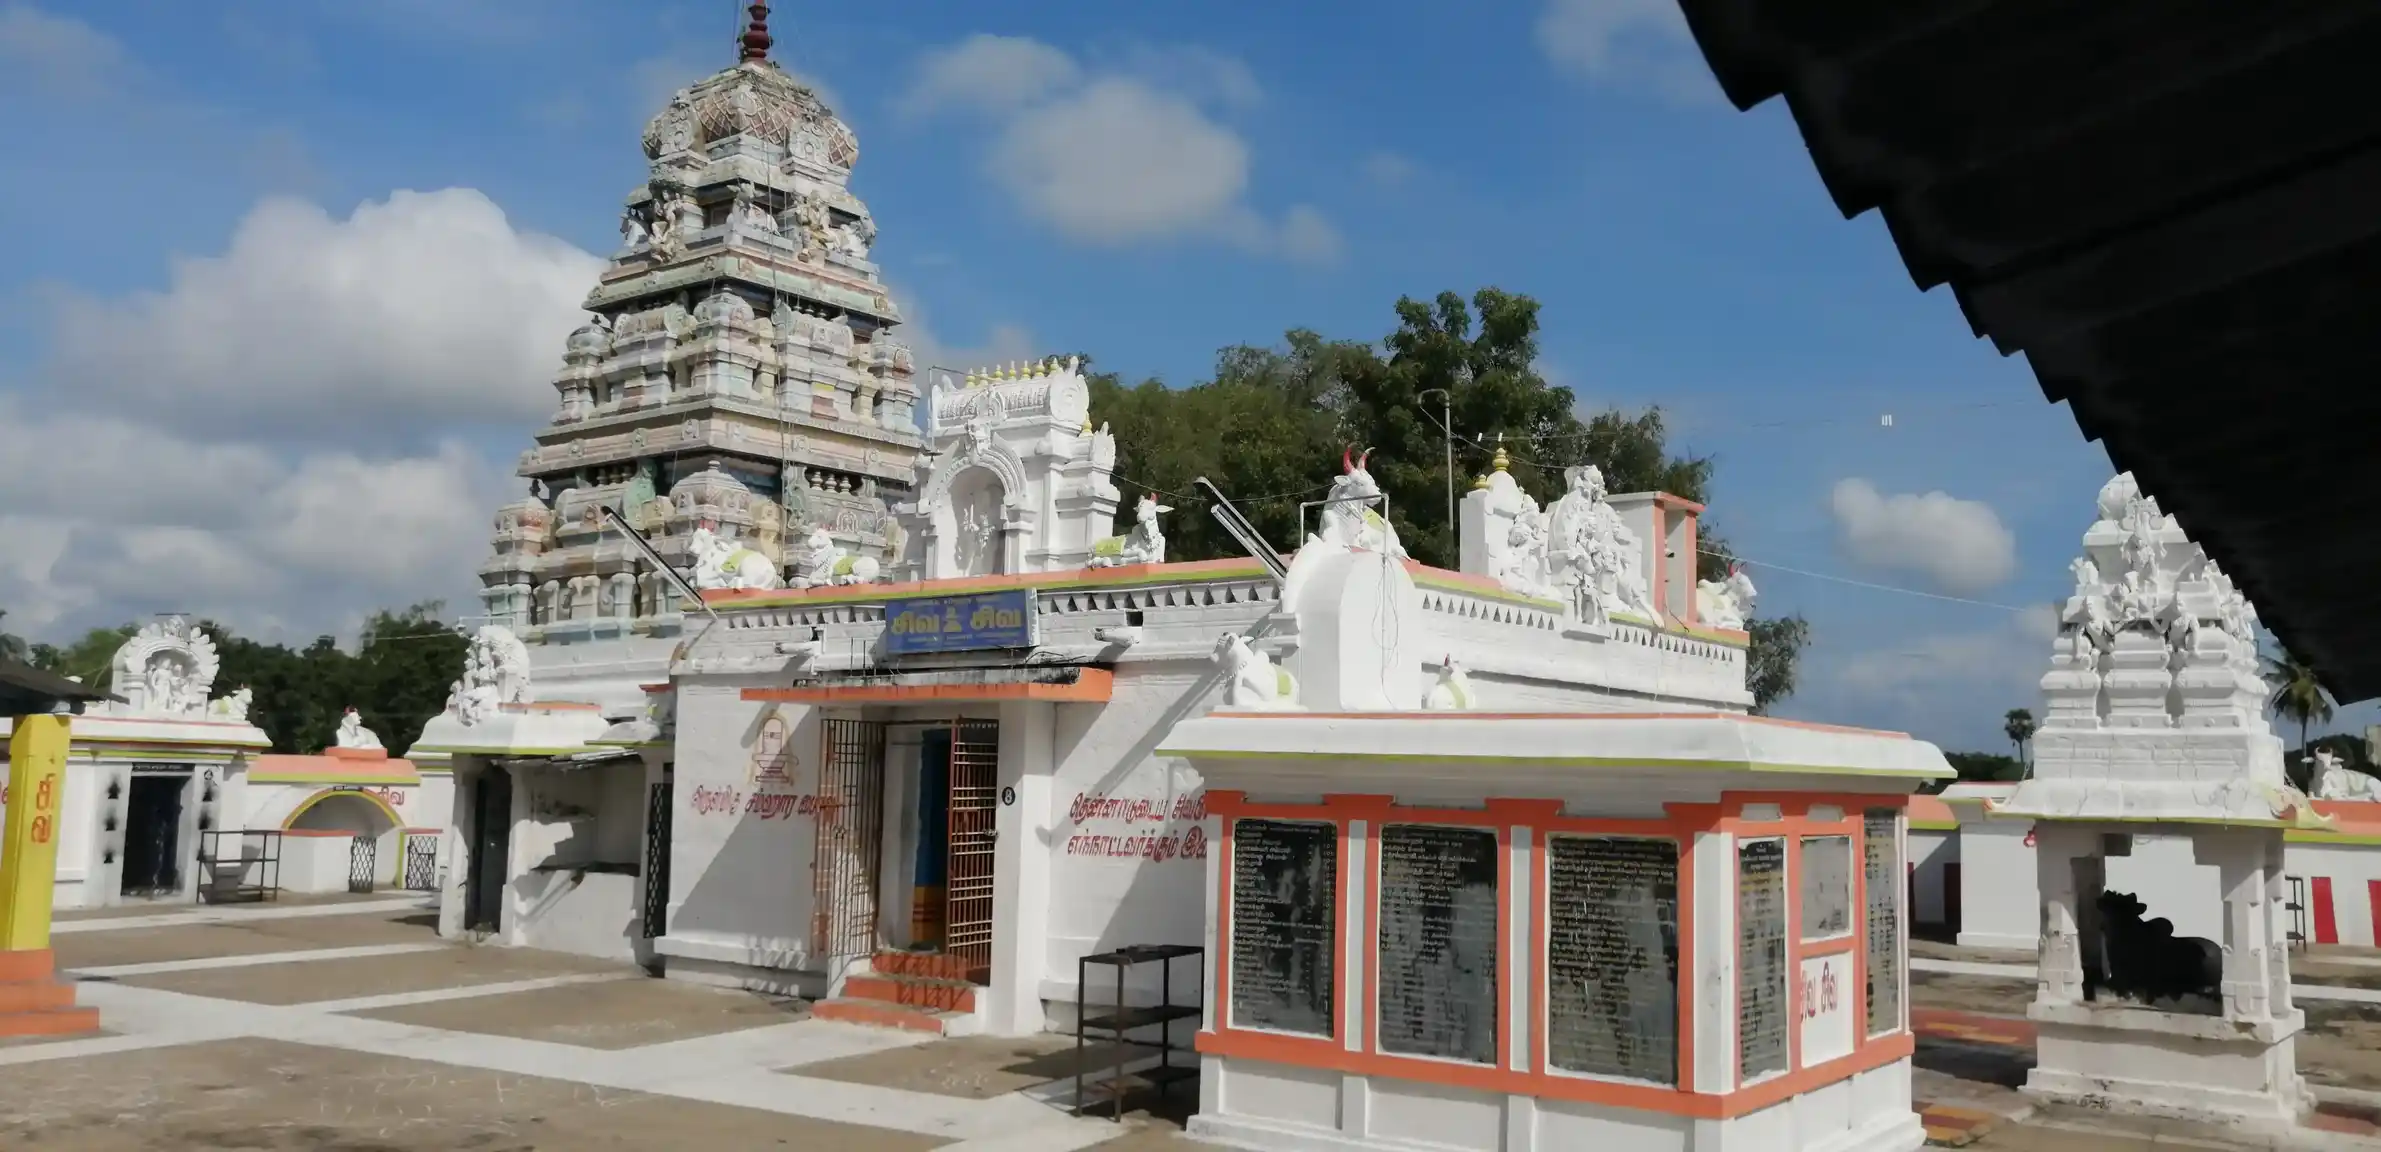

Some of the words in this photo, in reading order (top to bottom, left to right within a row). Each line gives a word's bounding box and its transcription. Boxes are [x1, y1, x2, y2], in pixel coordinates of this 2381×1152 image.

[891, 610, 940, 636] சிவ
[970, 605, 1021, 630] சிவ
[31, 772, 56, 844] சிவ
[1069, 792, 1168, 824] தென்னாடுடைய
